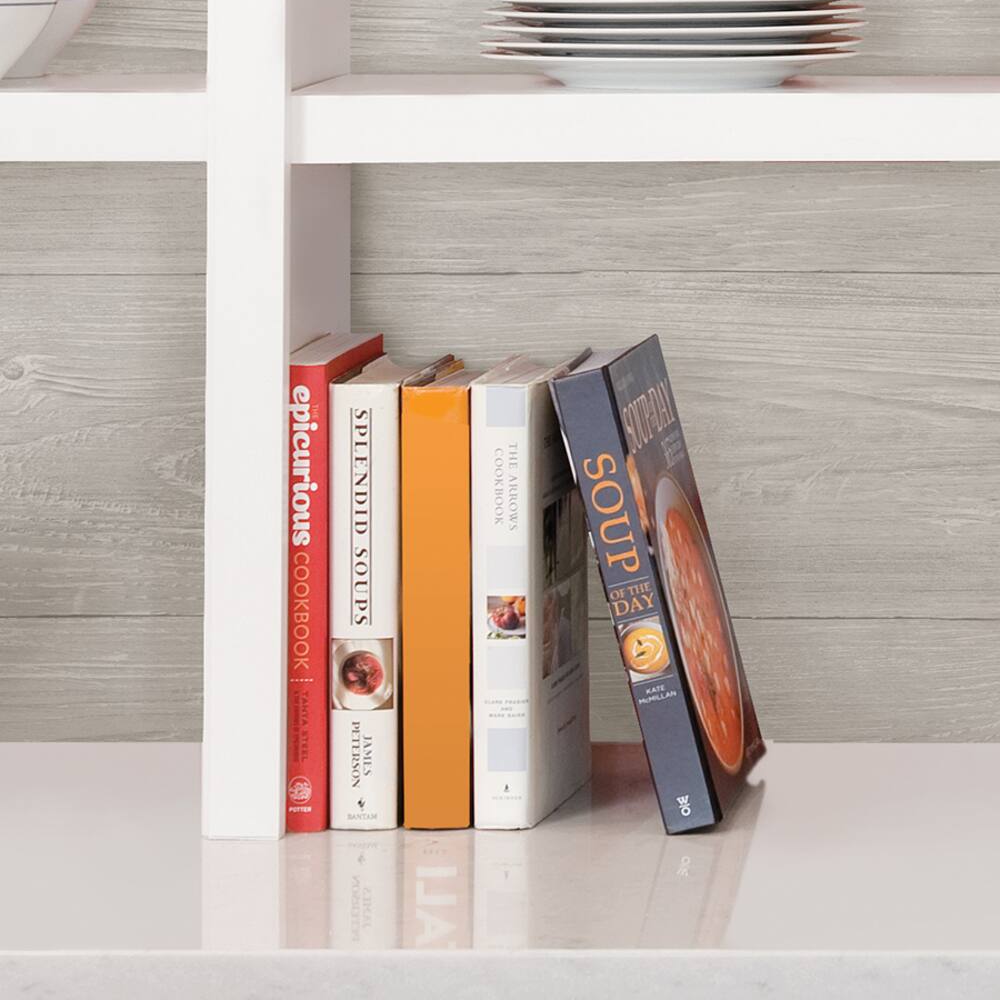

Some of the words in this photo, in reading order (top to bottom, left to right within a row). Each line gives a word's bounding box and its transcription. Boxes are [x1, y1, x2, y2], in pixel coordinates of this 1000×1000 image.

[289, 384, 318, 547] epicurious
[354, 408, 368, 535] SPLENDID
[494, 447, 504, 526] COOKBOOK
[508, 442, 518, 469] THE
[508, 475, 519, 532] ARROWS
[583, 453, 641, 574] SOUP
[293, 551, 310, 669] COOKBOOK
[354, 547, 368, 626] SOUPS
[610, 587, 625, 600] OF
[627, 582, 652, 596] THE
[612, 592, 655, 617] DAY
[645, 684, 665, 695] KATE
[352, 721, 361, 789] PETERSON
[363, 735, 373, 776] JAMES
